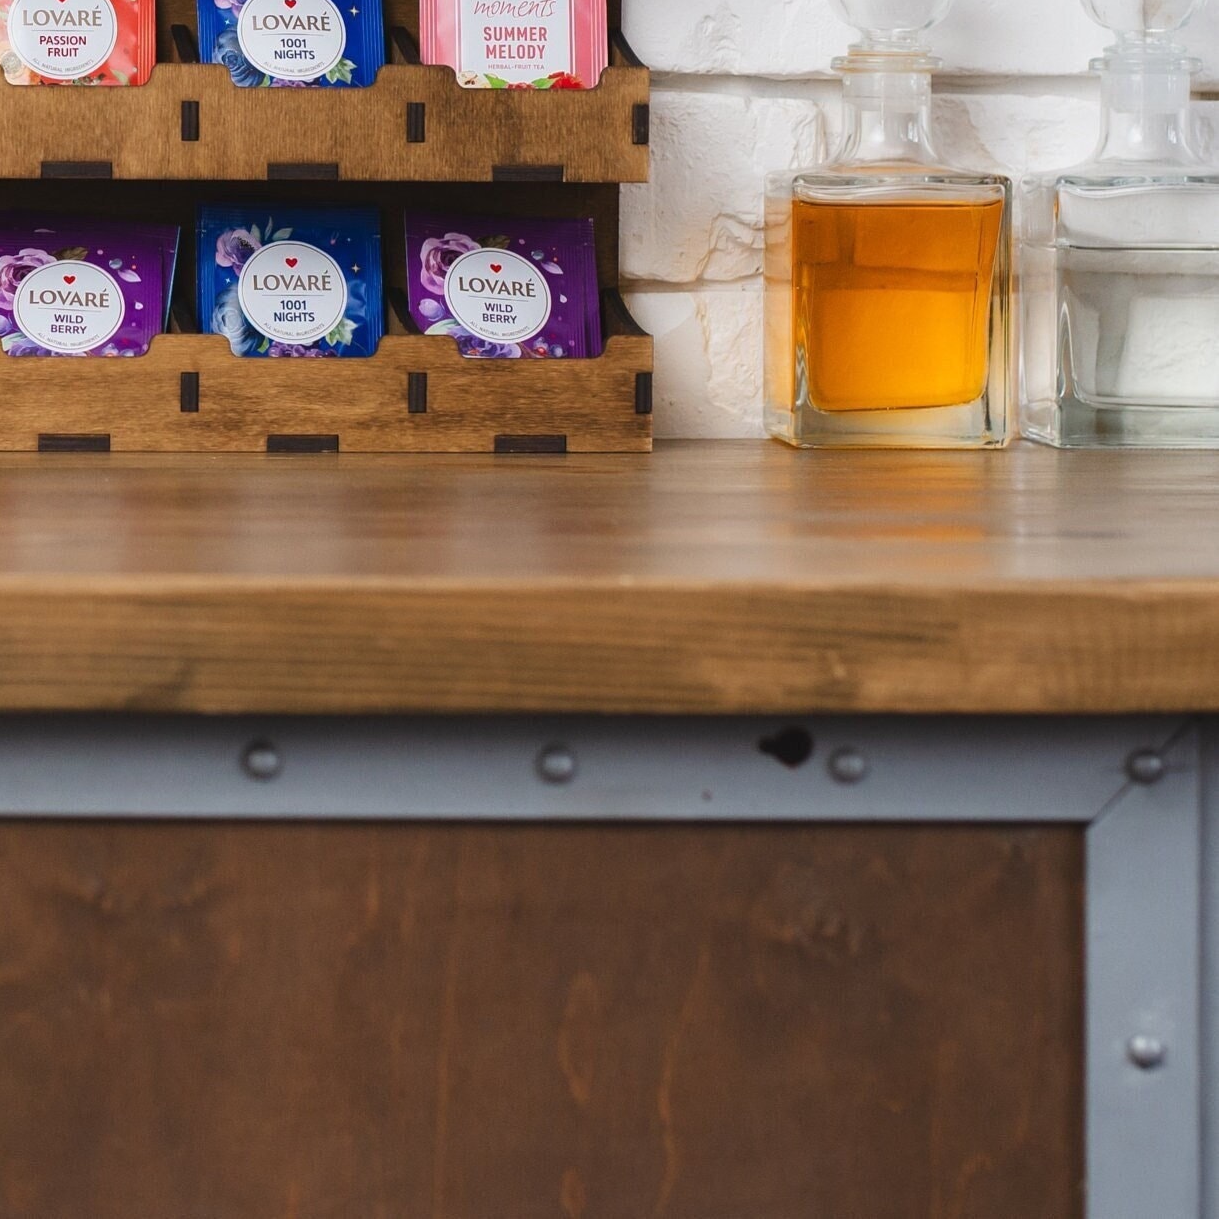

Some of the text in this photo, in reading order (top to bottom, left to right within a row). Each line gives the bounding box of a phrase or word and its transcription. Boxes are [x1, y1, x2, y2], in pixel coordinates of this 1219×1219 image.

[23, 5, 102, 26] LOVARÉ
[252, 11, 331, 31] LOVARÉ
[483, 27, 547, 41] SUMMER
[39, 36, 87, 45] PASSION
[280, 39, 307, 48] 1001
[47, 48, 79, 57] FRUIT
[274, 51, 315, 60] NIGHTS
[486, 45, 545, 59] MELODY
[253, 270, 332, 291] LOVARÉ
[459, 276, 536, 298] LOVARÉ
[30, 288, 109, 308] LOVARÉ
[280, 300, 307, 310] 1001
[484, 302, 513, 313] WILD
[54, 314, 83, 324] WILD
[274, 312, 315, 322] NIGHTS
[482, 314, 517, 324] BERRY
[50, 325, 87, 334] BERRY
